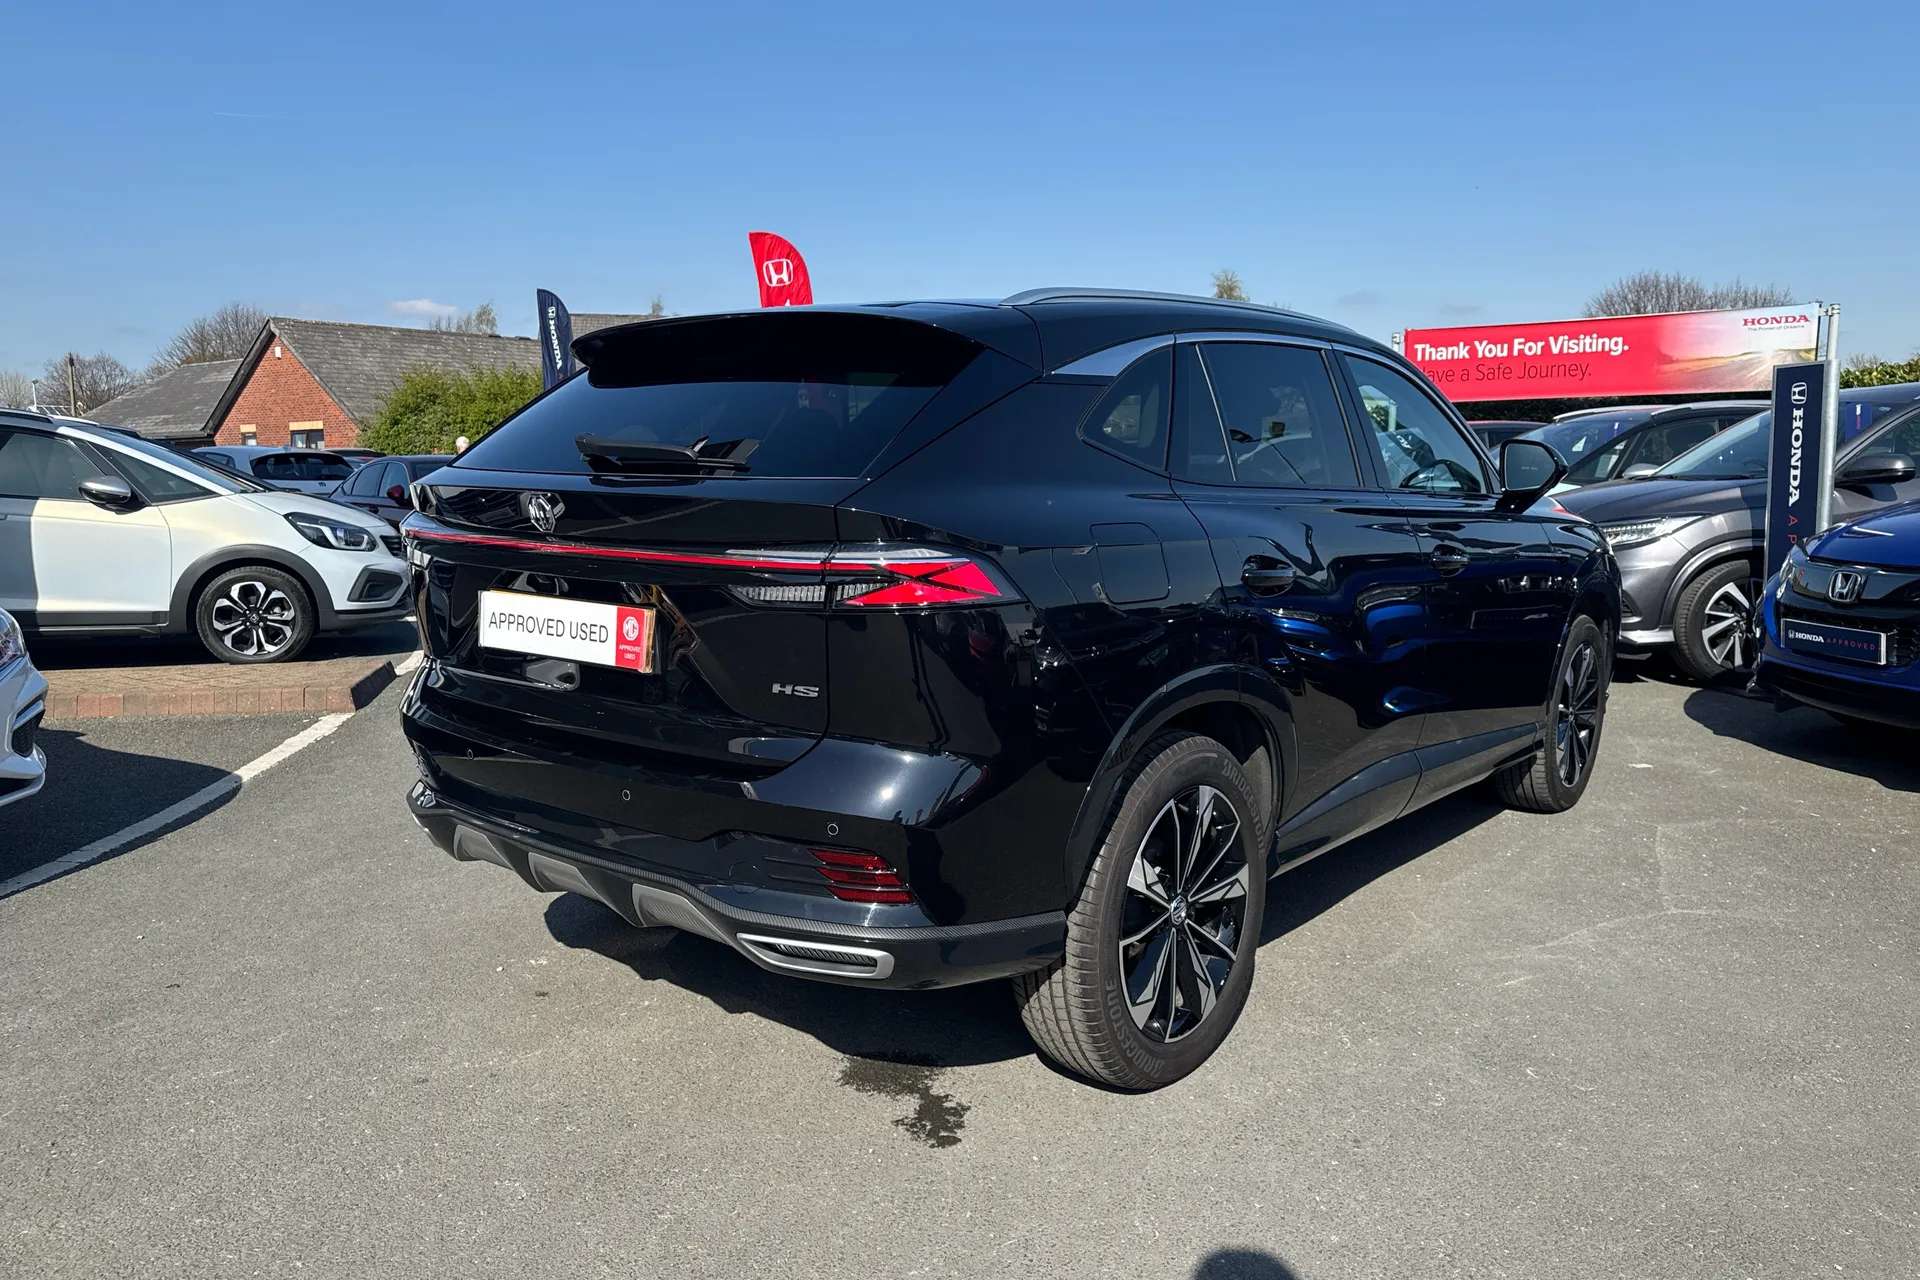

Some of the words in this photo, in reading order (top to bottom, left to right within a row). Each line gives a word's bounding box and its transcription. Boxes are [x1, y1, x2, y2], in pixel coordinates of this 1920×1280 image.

[1743, 315, 1810, 327] HONDA
[549, 319, 562, 370] HONDA
[1414, 342, 1471, 361] Thank
[1473, 340, 1508, 358] You
[1513, 338, 1545, 356] For
[1548, 333, 1630, 356] Visiting.
[1460, 368, 1470, 382] a
[1475, 362, 1513, 382] Safe
[1517, 361, 1592, 381] Journey.
[1789, 408, 1804, 507] HONDA
[489, 611, 565, 638] APPROVED
[569, 621, 609, 643] USED
[1795, 631, 1825, 643] HONDA
[1826, 637, 1876, 650] APPROVED
[772, 683, 819, 697] HS
